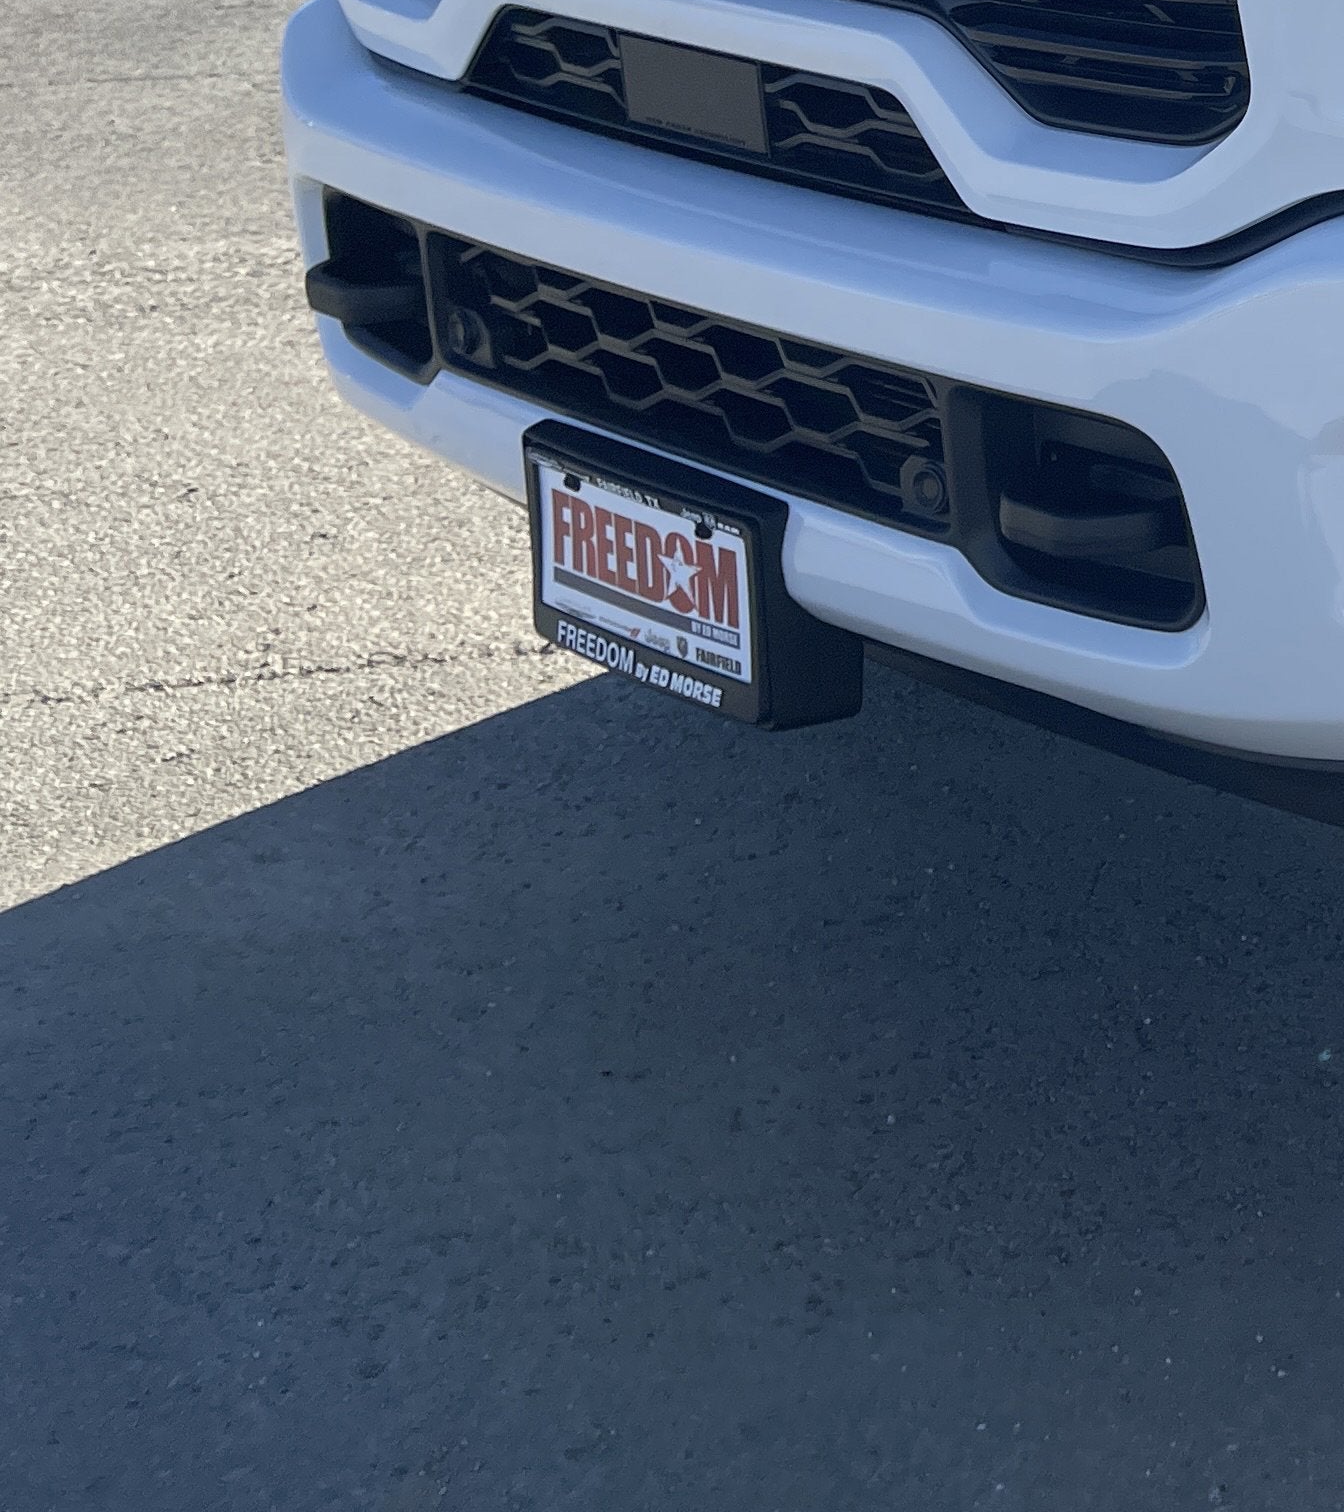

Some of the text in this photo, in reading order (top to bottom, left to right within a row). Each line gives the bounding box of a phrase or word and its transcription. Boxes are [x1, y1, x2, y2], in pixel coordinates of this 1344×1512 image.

[551, 487, 740, 628] FREEDOM
[557, 619, 635, 675] FREEDOM
[650, 664, 670, 688] ED
[670, 671, 723, 708] MORSE
